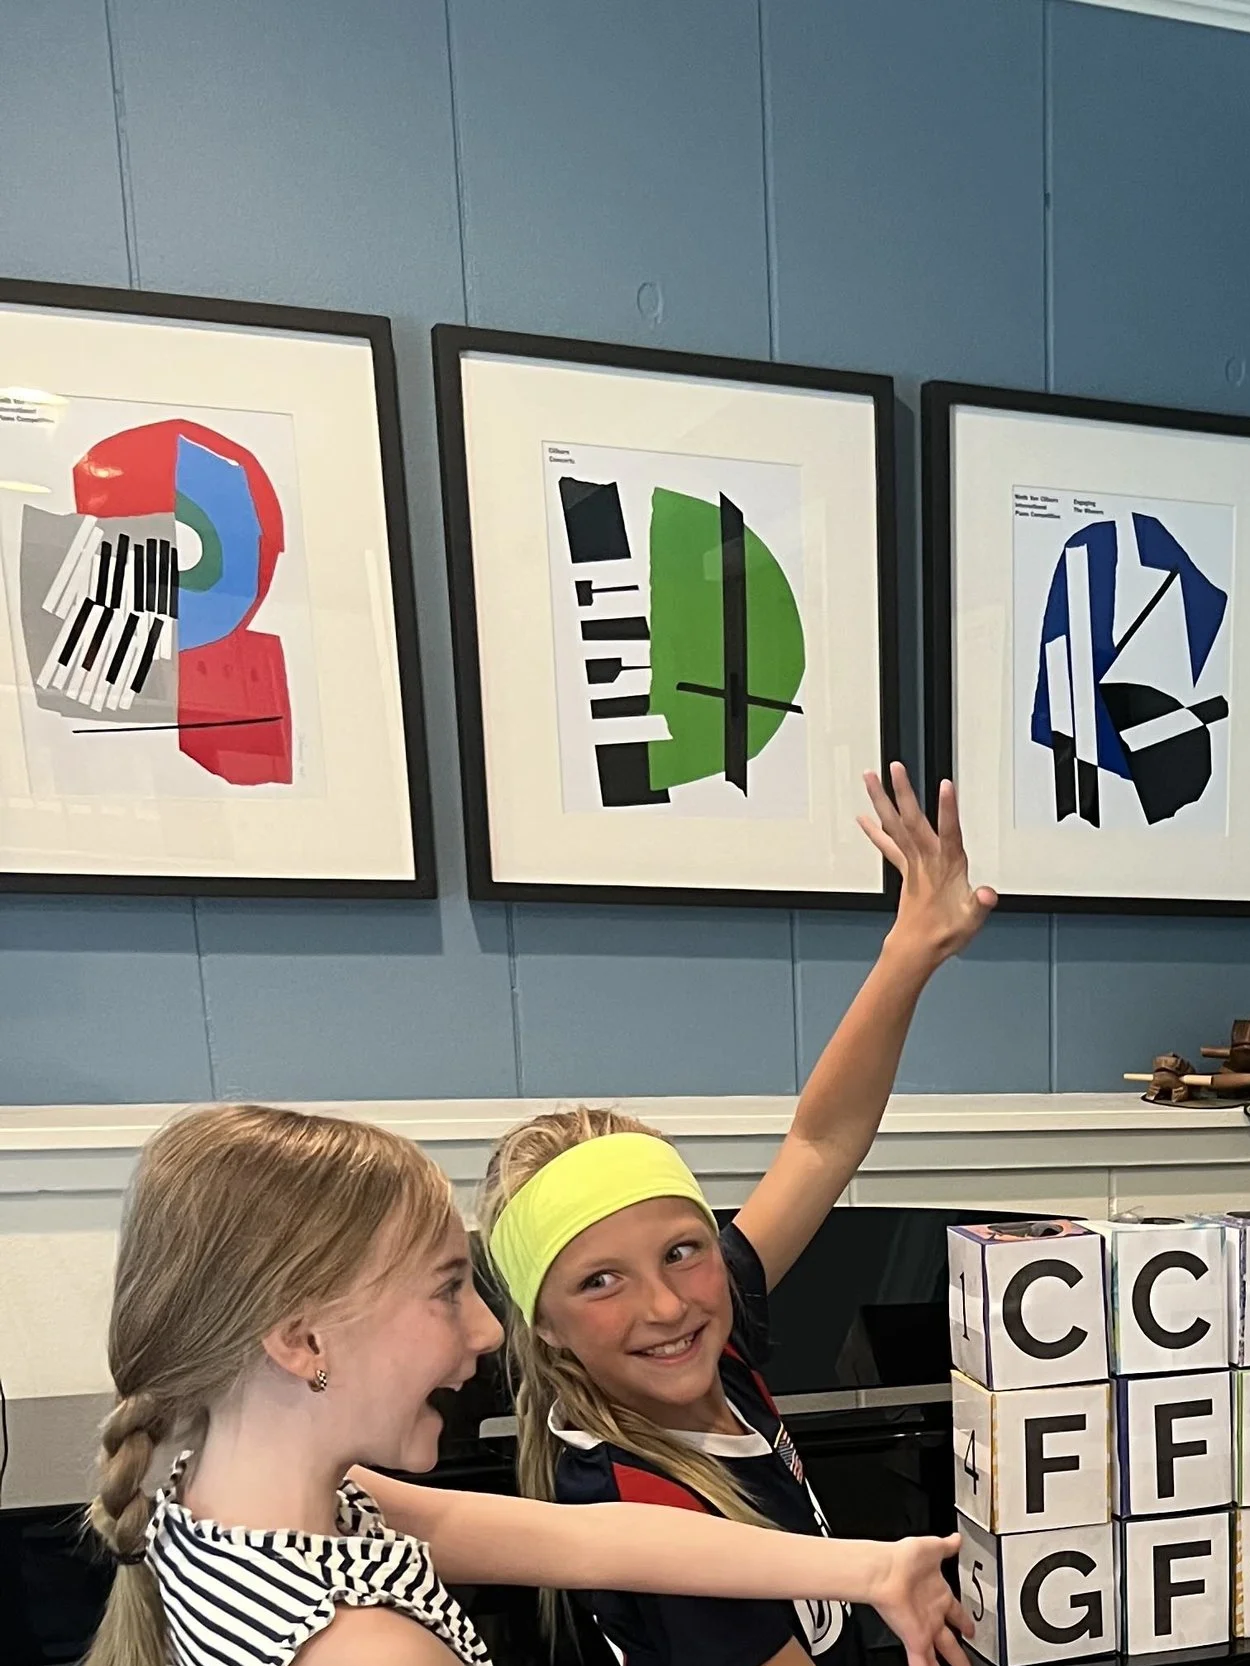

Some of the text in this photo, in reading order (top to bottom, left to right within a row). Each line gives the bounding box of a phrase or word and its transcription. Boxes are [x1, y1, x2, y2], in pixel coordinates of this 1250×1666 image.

[956, 1271, 971, 1342] 1
[1002, 1259, 1088, 1360] C
[1132, 1250, 1211, 1350] C
[963, 1429, 980, 1495] 4
[1024, 1413, 1087, 1514] F
[1154, 1398, 1213, 1500] F
[970, 1560, 984, 1622] 5
[1019, 1550, 1104, 1645] G
[1153, 1539, 1212, 1637] F
